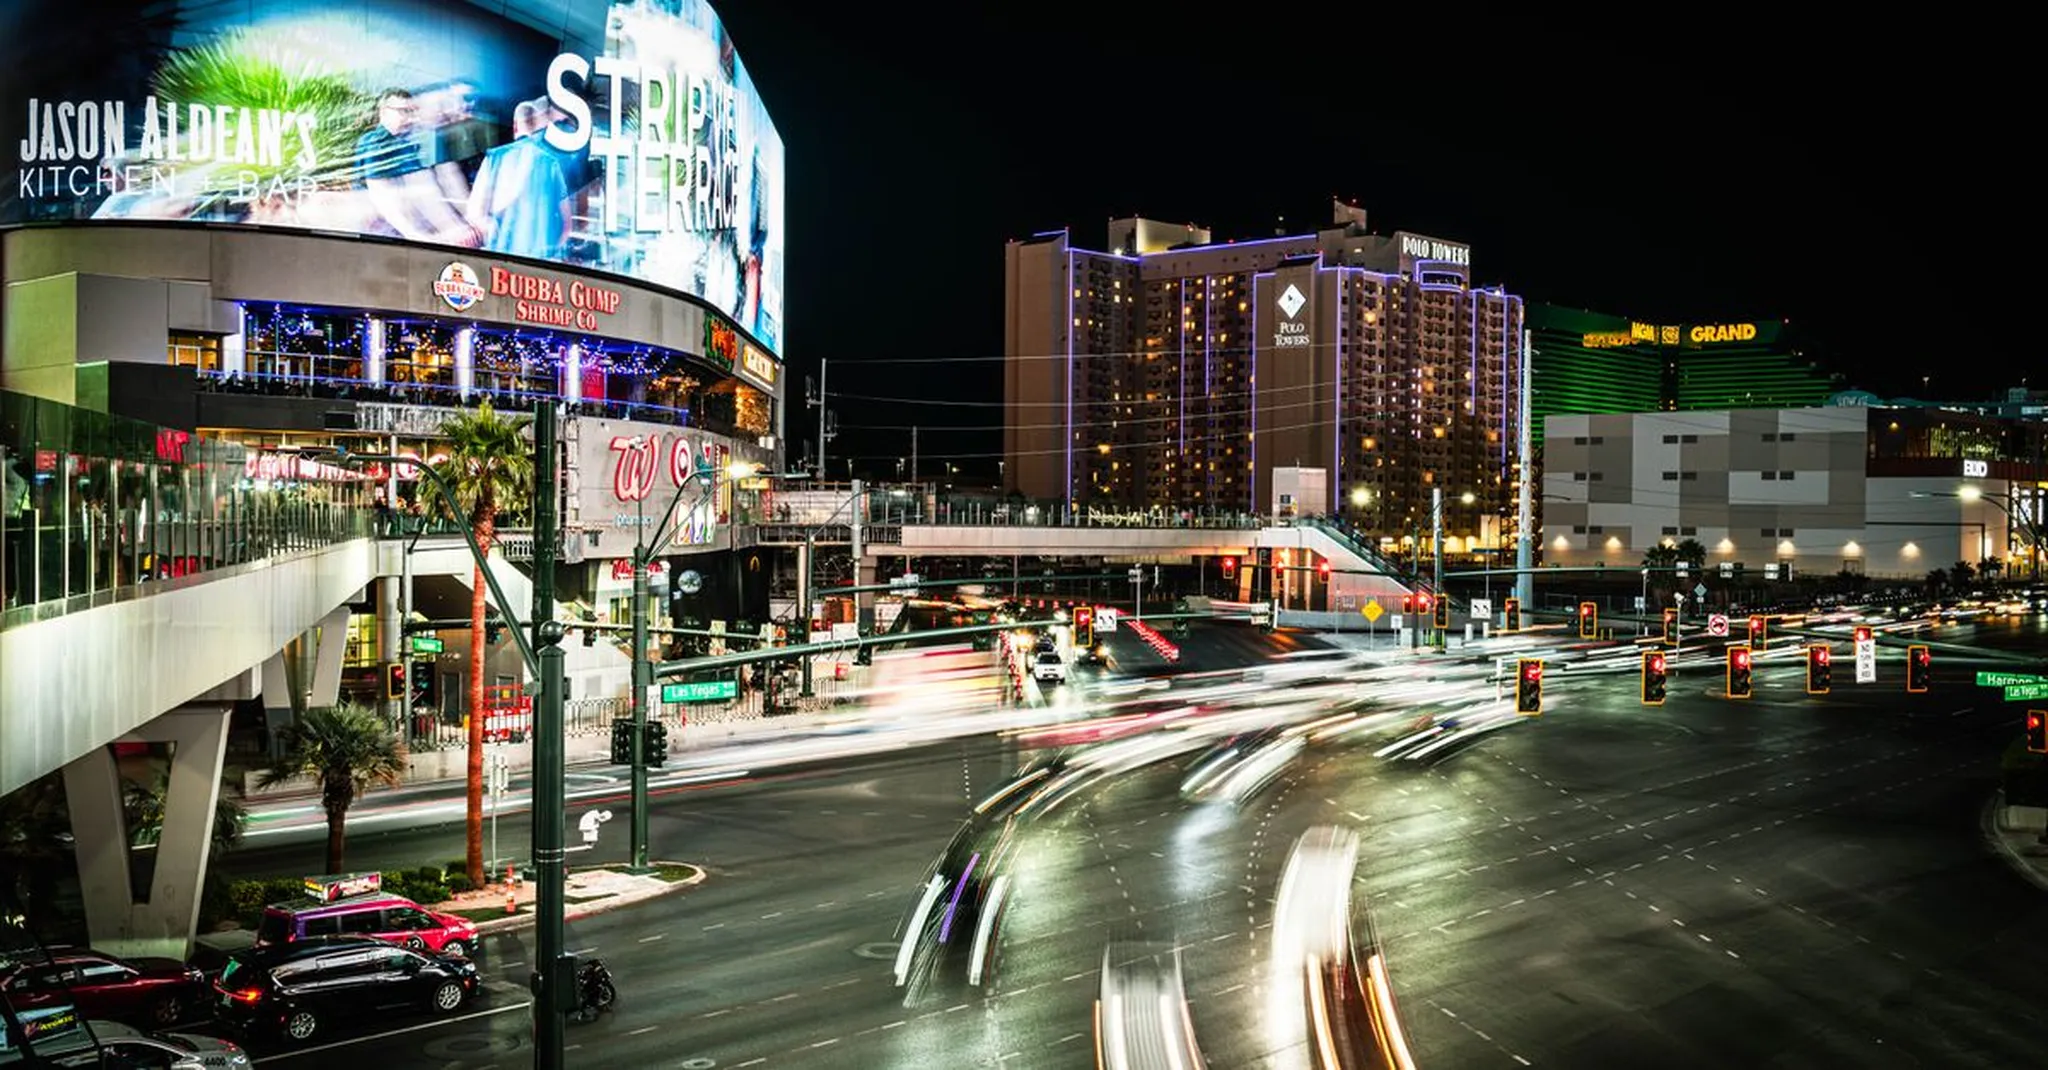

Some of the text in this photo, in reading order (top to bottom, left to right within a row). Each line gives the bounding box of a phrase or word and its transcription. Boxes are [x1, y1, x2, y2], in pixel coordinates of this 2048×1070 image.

[544, 52, 708, 152] STRIP
[20, 95, 318, 170] JASON ALDEAN'S
[20, 166, 177, 198] KITCHEN
[589, 137, 738, 235] TERRACE
[1402, 236, 1470, 265] POLO TOWERS
[490, 265, 621, 316] BUBBA GUMP
[516, 300, 573, 327] SHRIMP
[1274, 333, 1310, 347] TOWERS
[1280, 322, 1304, 334] POLO
[1690, 323, 1757, 342] GRAND
[672, 686, 688, 698] Las
[690, 683, 720, 699] Vegas
[2010, 686, 2020, 697] Las
[2021, 685, 2039, 699] Vegas
